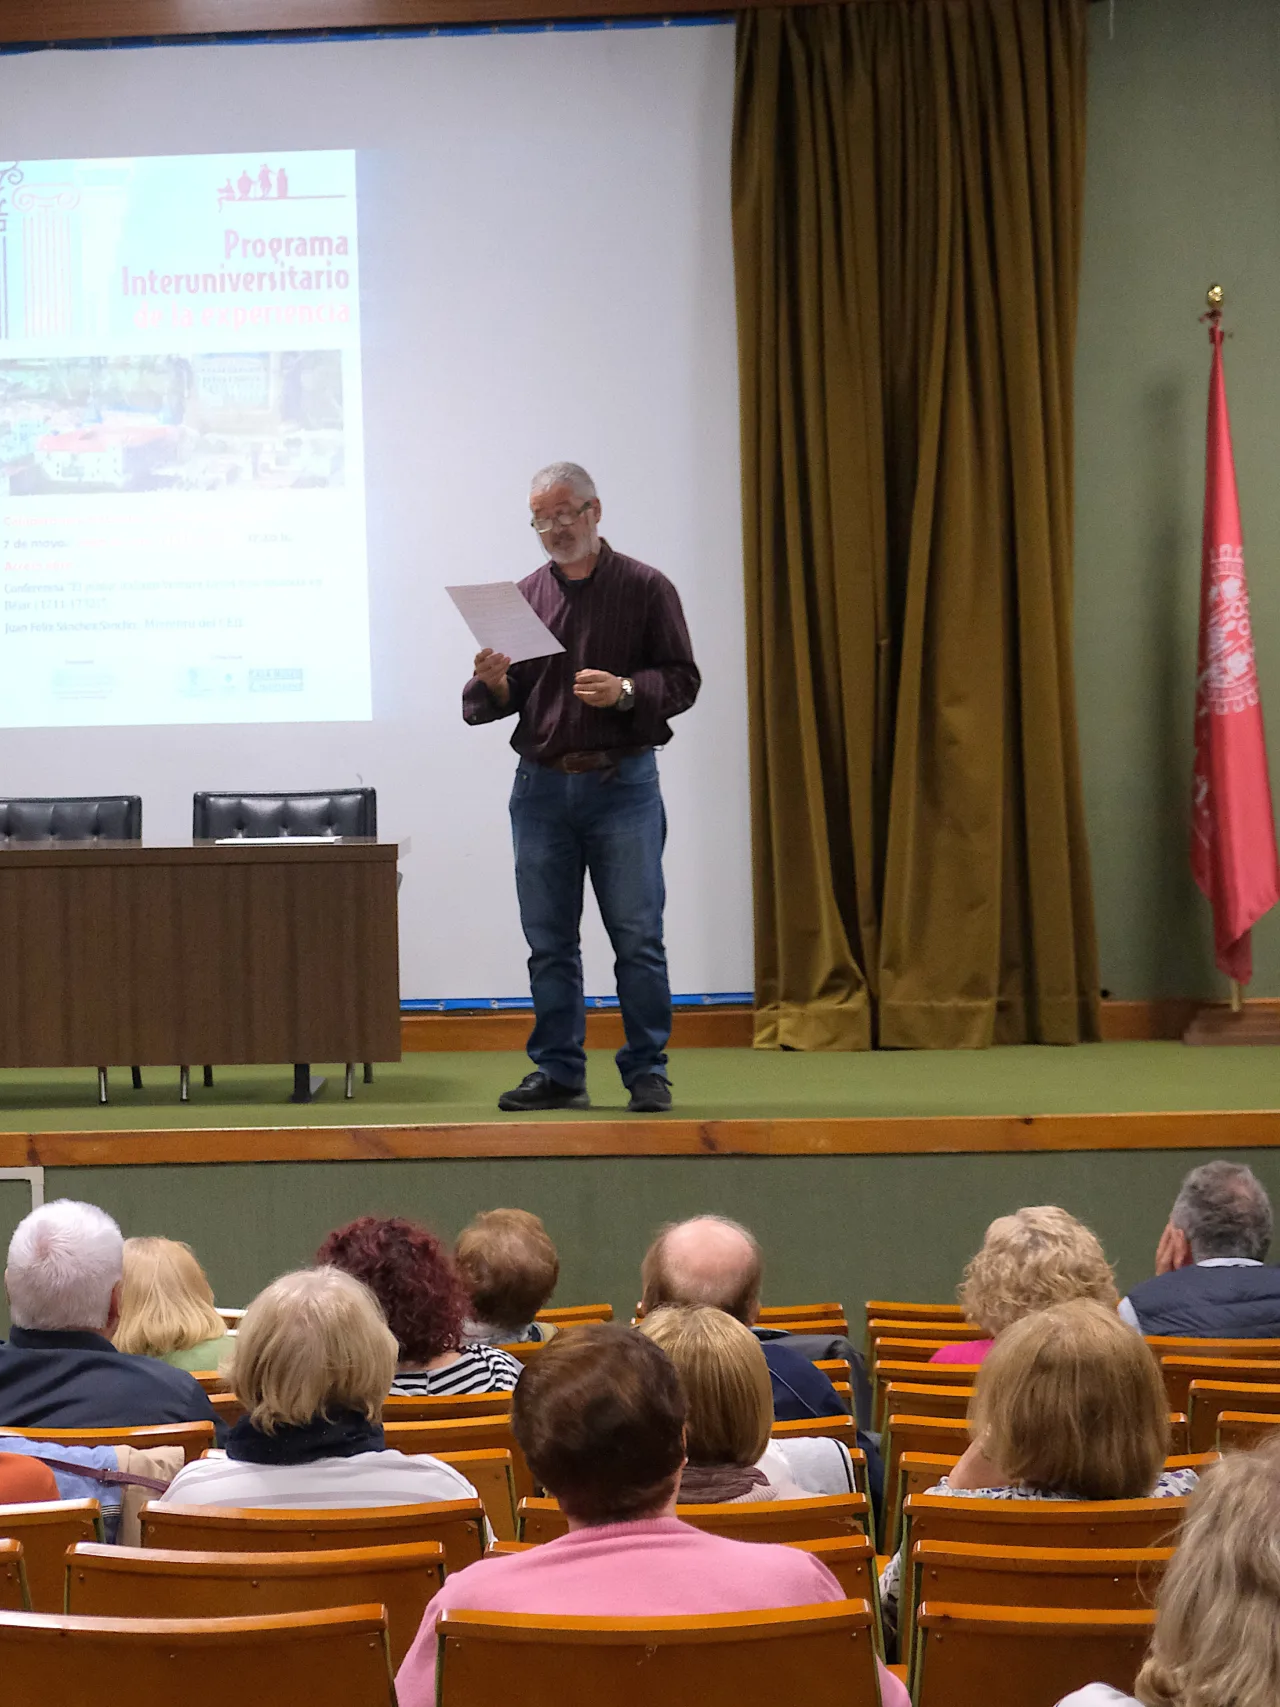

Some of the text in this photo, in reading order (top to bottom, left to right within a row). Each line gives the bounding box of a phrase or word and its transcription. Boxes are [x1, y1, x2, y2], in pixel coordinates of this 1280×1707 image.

[224, 229, 349, 263] Programa
[122, 260, 350, 296] Interuniversitario
[133, 298, 351, 332] de la experiencia
[13, 538, 28, 549] de
